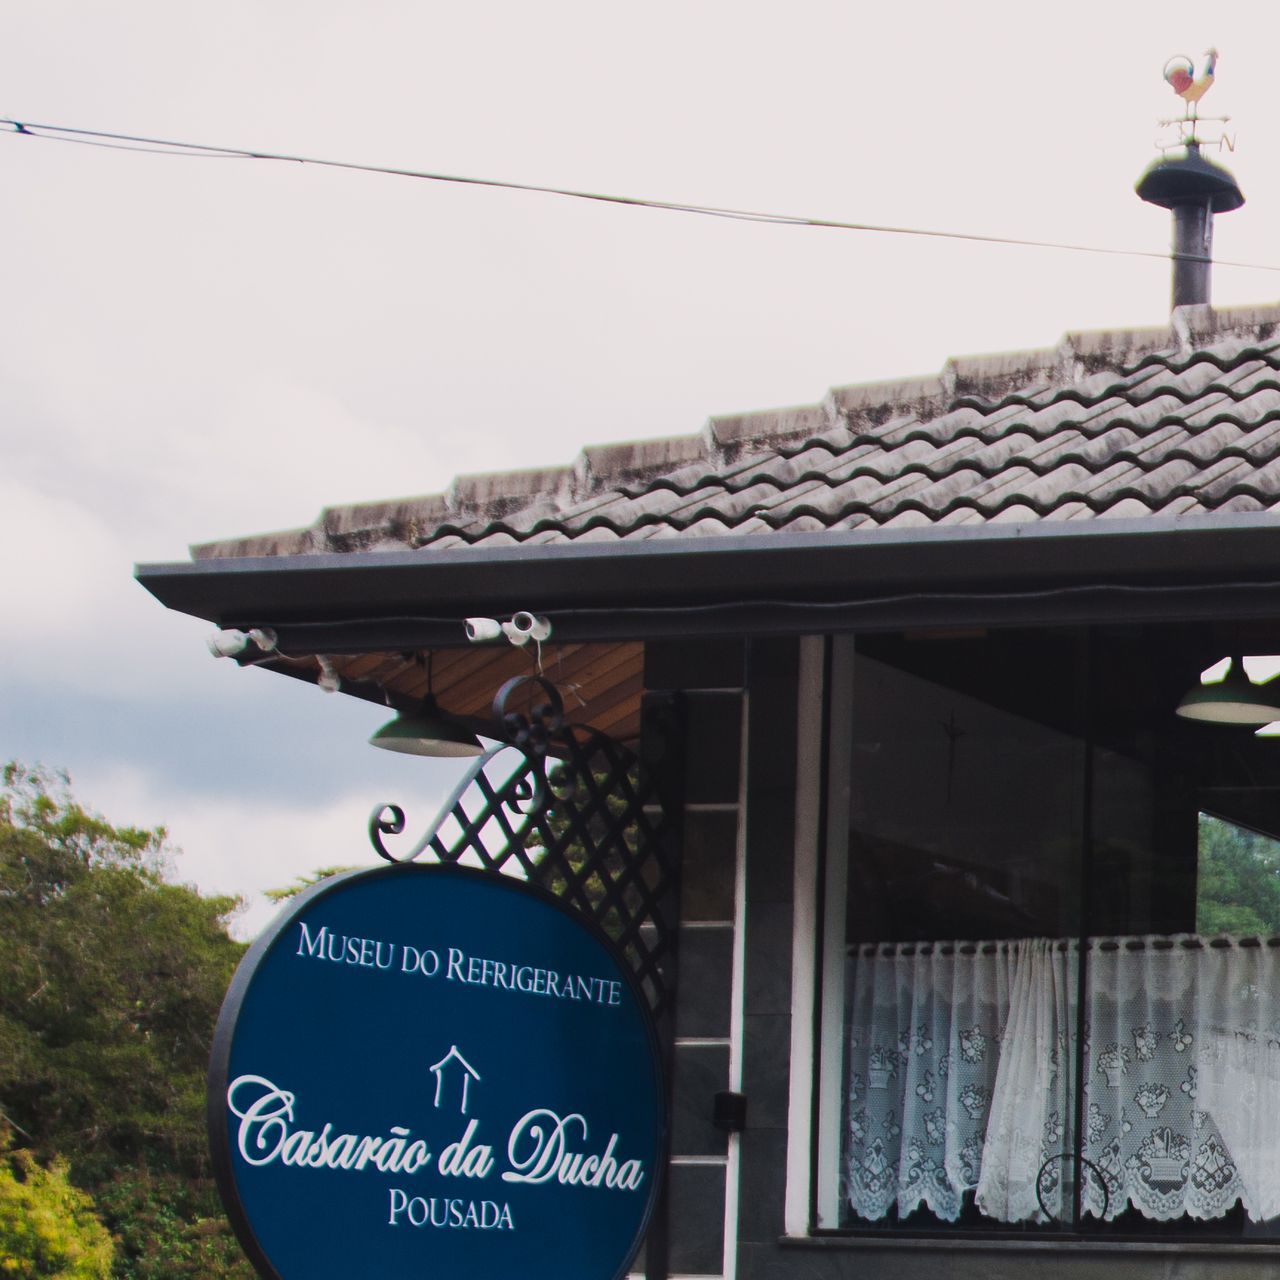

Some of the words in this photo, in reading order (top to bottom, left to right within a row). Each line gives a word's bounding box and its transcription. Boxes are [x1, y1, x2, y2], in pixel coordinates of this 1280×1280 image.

[297, 922, 394, 969] MUSEU
[401, 946, 439, 977] DO
[446, 948, 622, 1006] REFRIGERANTE
[227, 1074, 431, 1175] Casarão
[438, 1119, 495, 1179] da
[501, 1108, 645, 1191] Ducha
[388, 1188, 515, 1231] POUSADA
